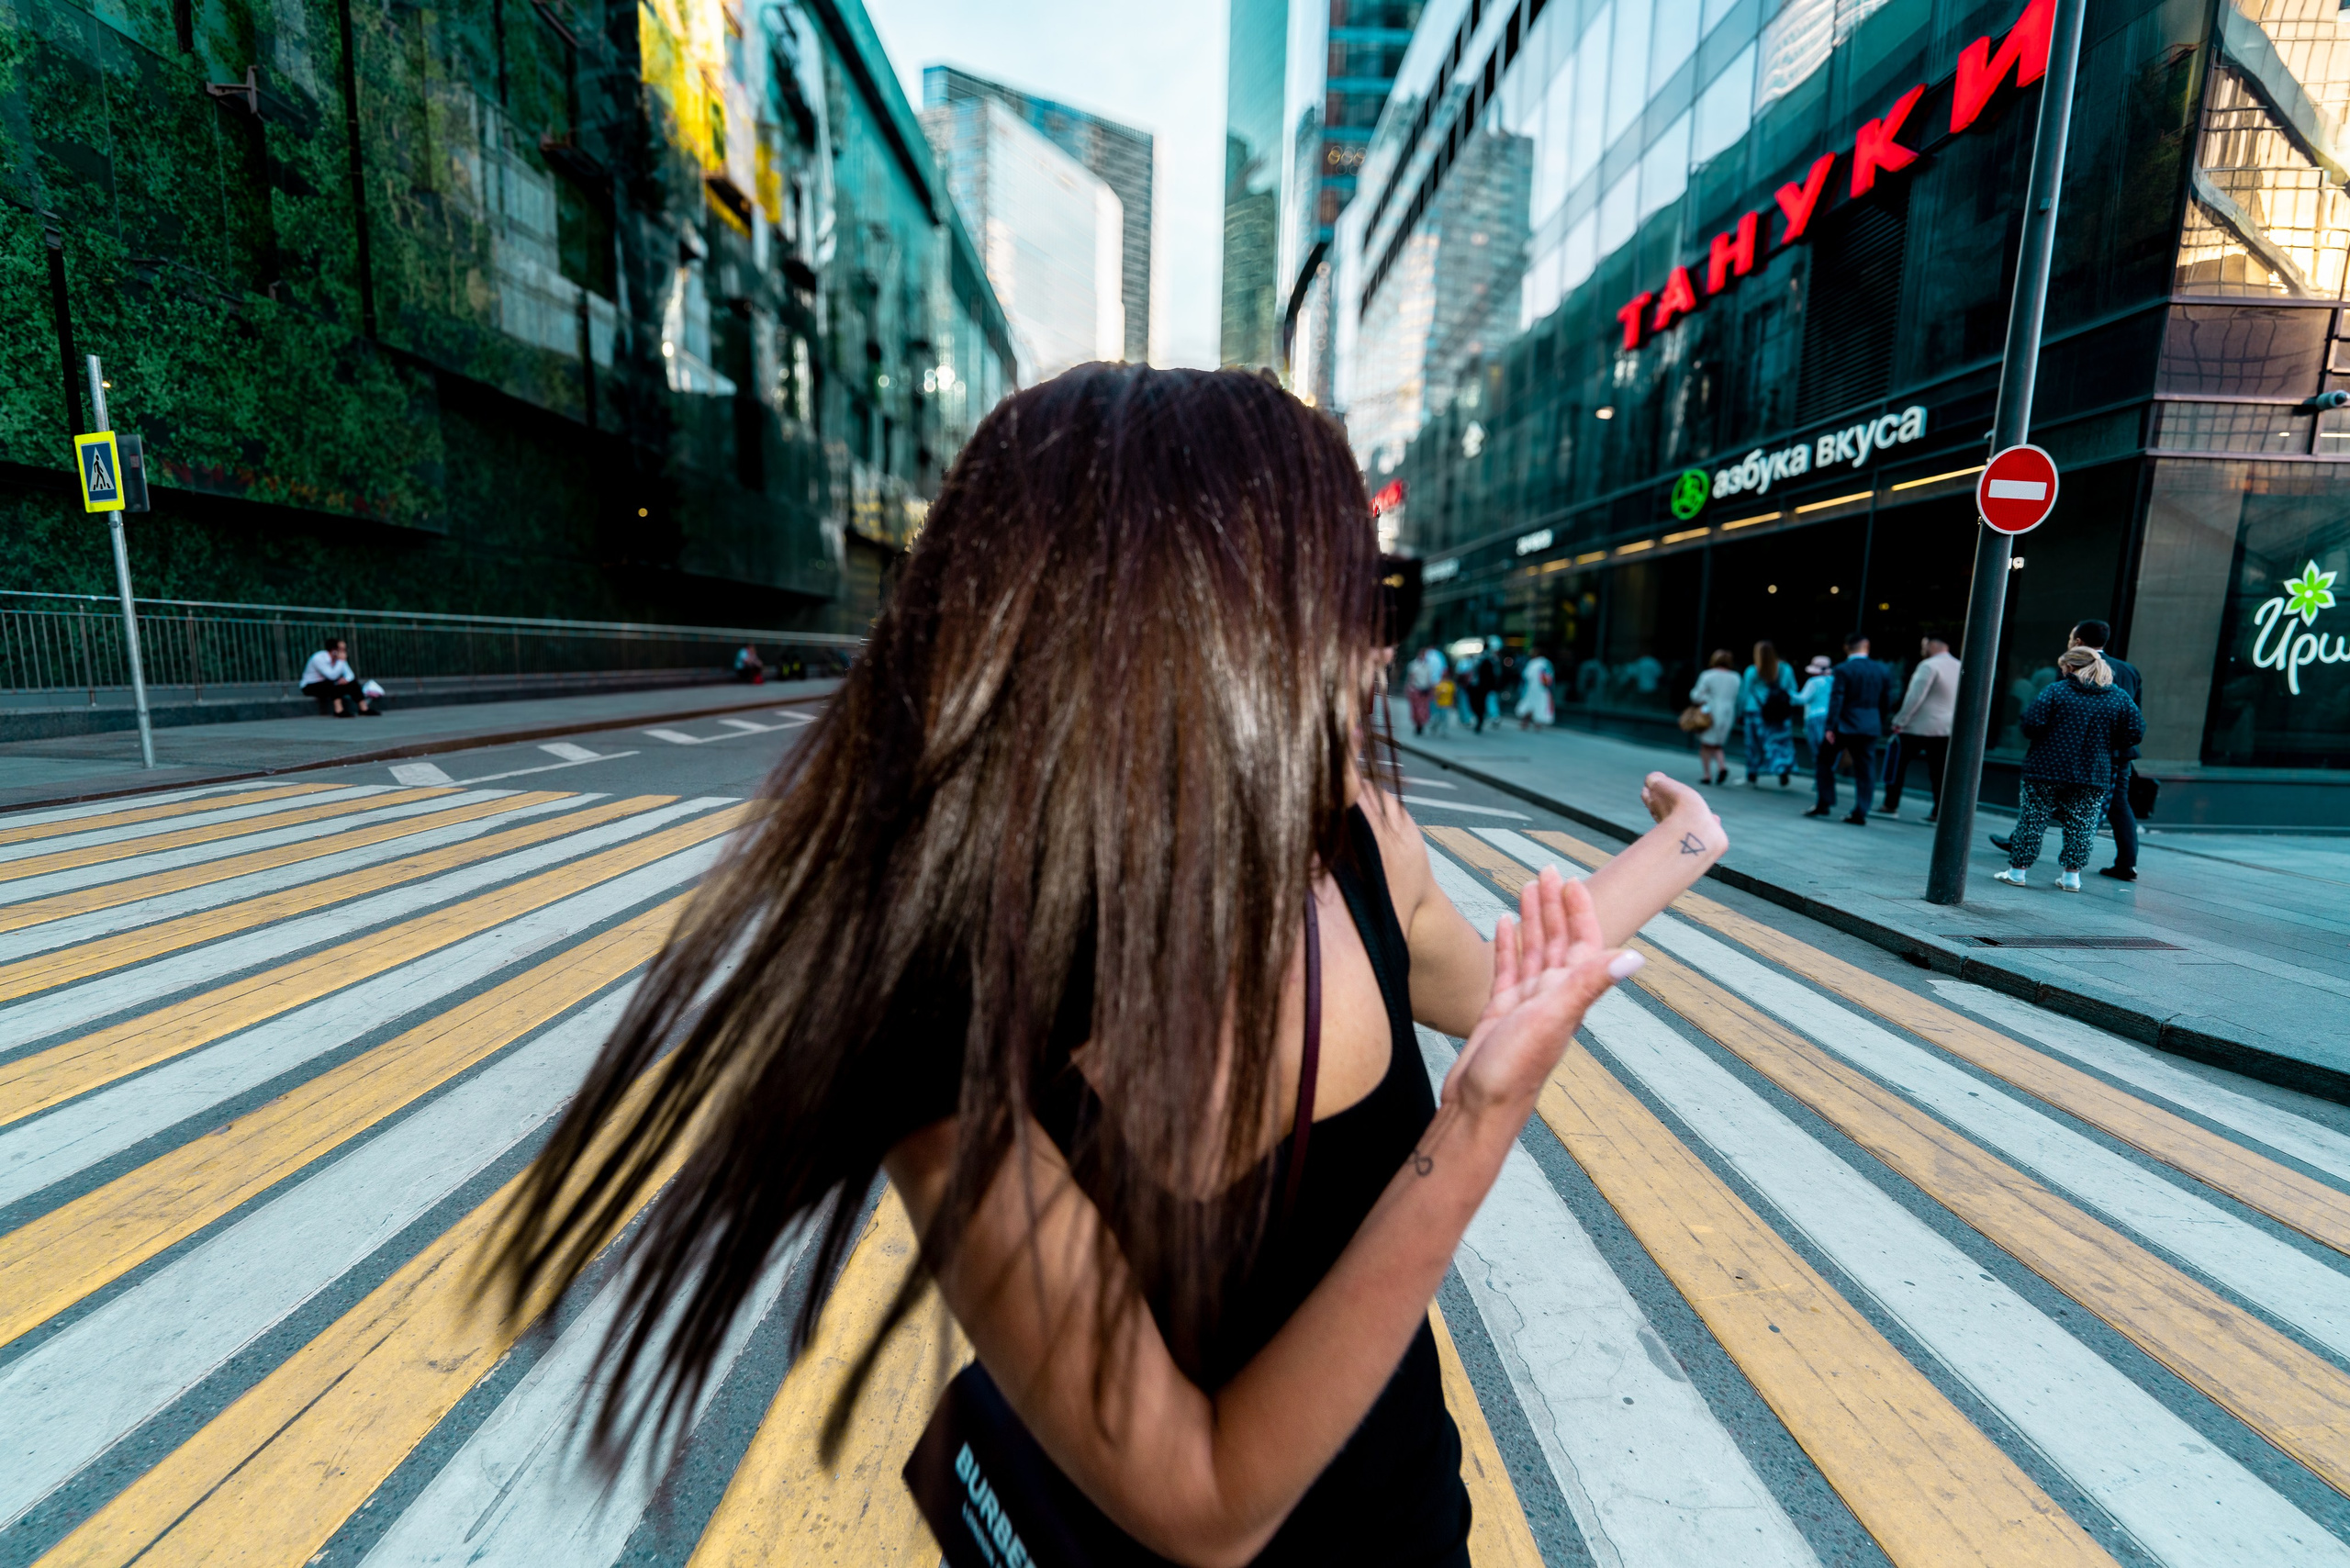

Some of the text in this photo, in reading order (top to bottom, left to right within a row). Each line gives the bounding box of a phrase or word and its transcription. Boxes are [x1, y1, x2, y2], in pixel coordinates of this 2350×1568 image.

[1617, 0, 2056, 350] ТАНУКИ
[1712, 405, 1928, 495] азбука вкуса
[955, 1439, 1037, 1568] BURBE
